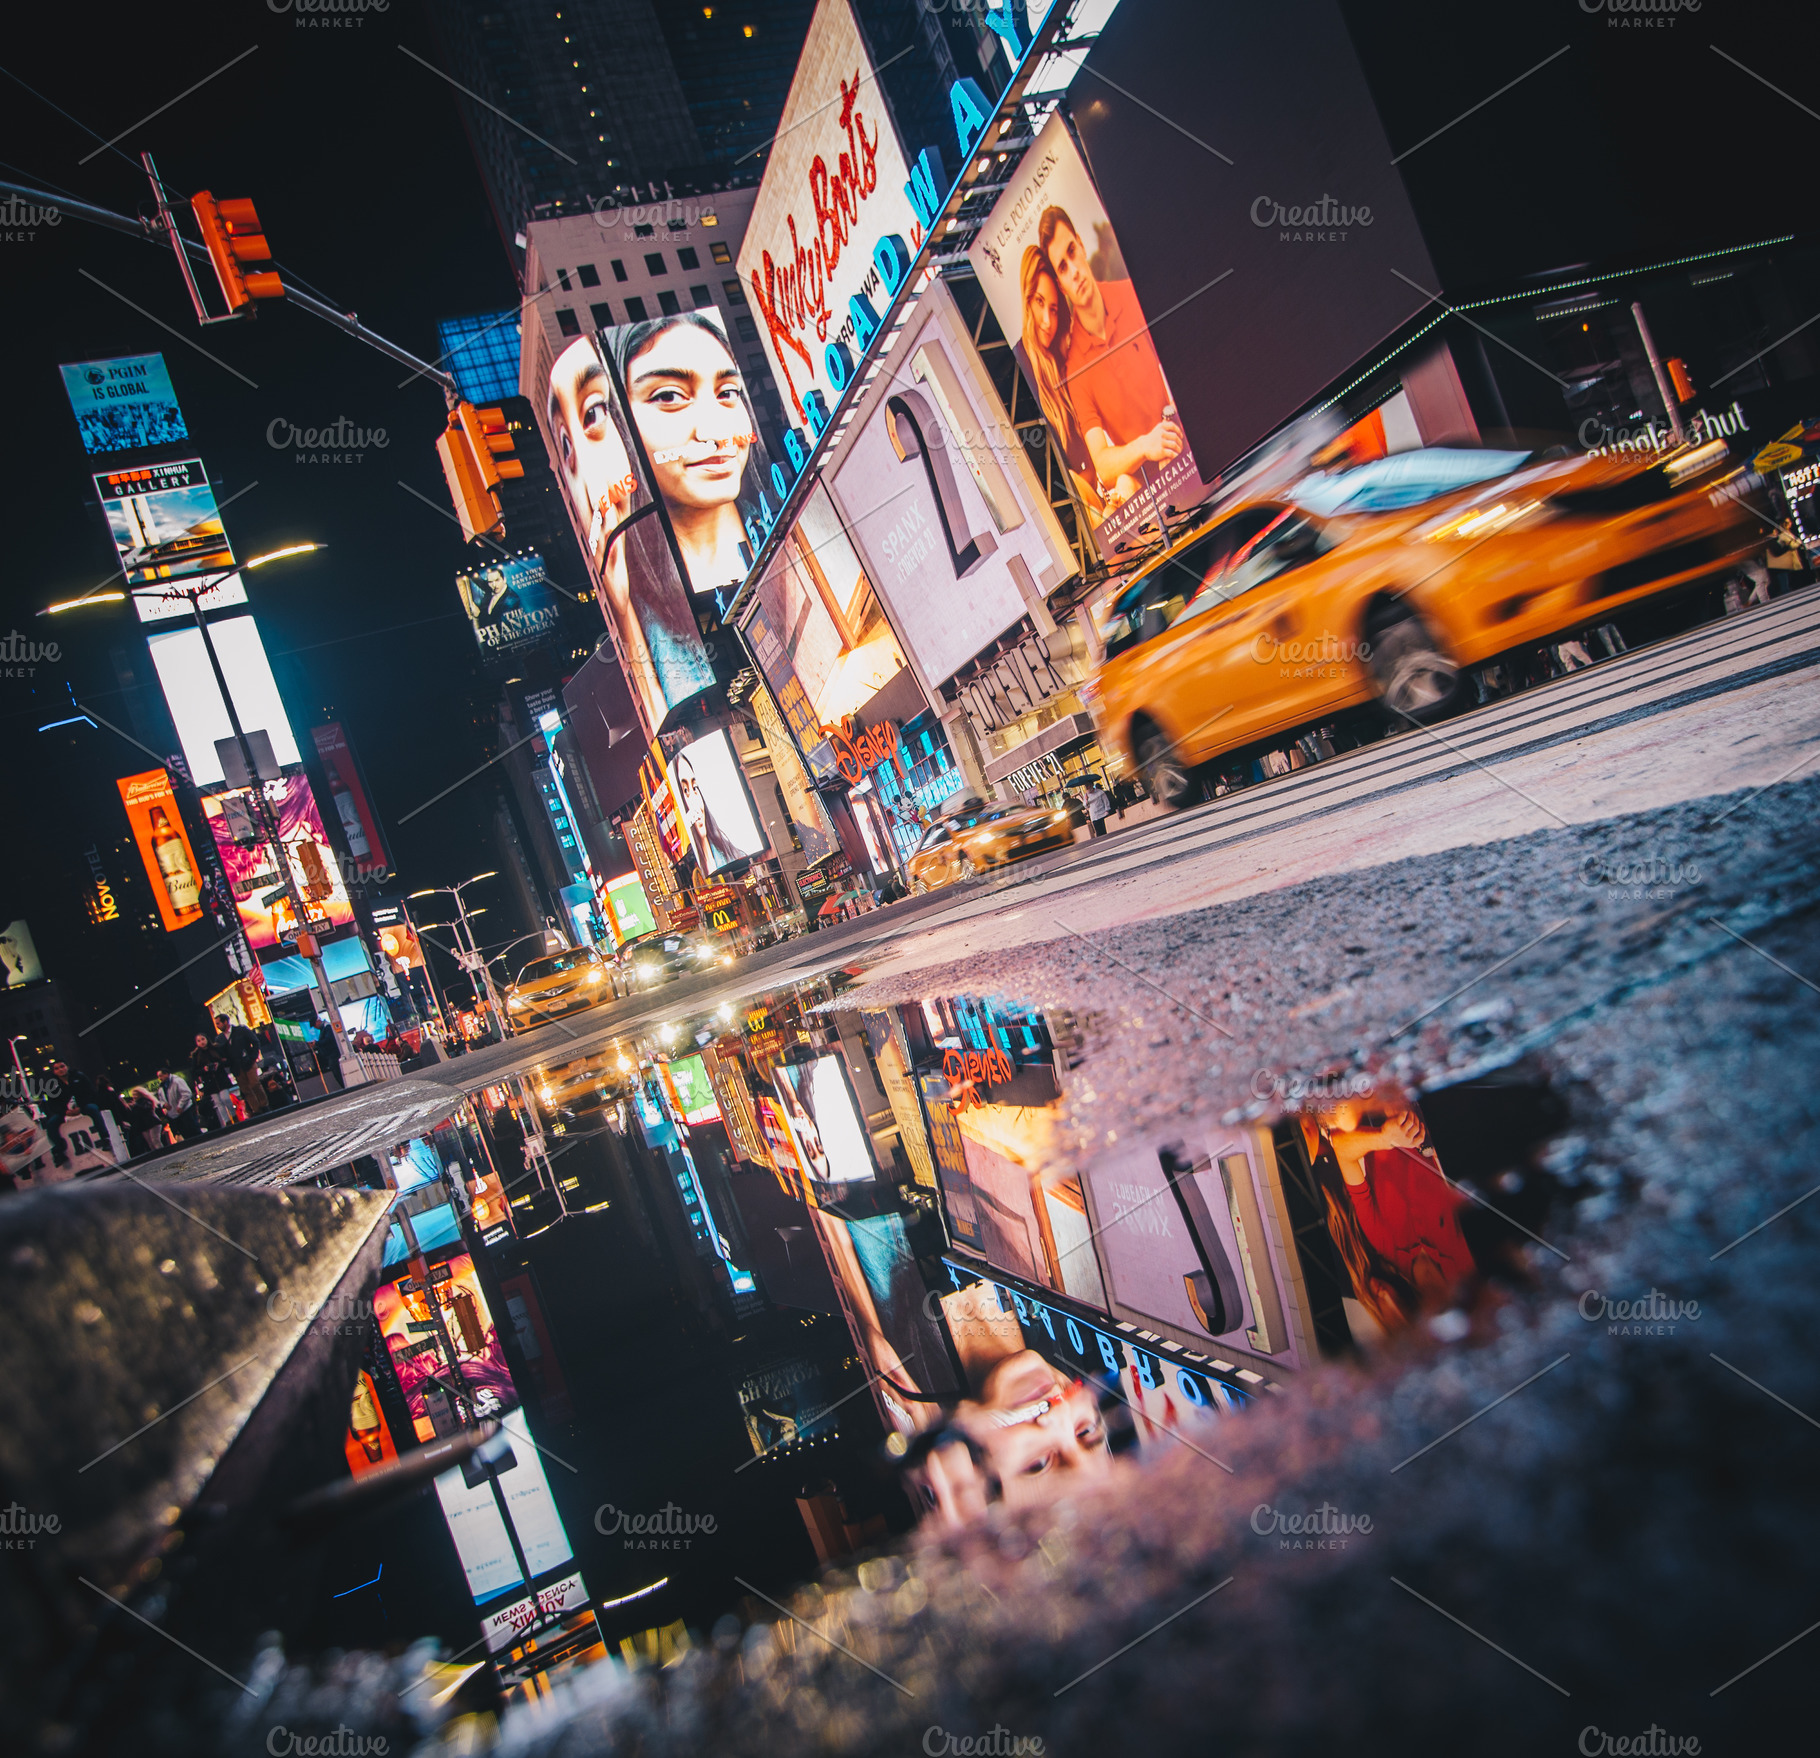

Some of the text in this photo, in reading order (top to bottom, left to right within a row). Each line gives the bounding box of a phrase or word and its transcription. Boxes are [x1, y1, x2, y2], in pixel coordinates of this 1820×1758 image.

[1010, 187, 1034, 227] POLO
[1033, 150, 1059, 193] ASSN.
[752, 68, 878, 426] Kinky Boots
[92, 381, 150, 400] IS GLOBAL
[108, 364, 147, 380] PGIM
[1700, 401, 1750, 440] hut
[153, 464, 189, 478] XINHUA
[884, 339, 1027, 581] 21
[115, 474, 190, 496] GALLERY
[1104, 452, 1193, 535] LIVE AUTHENTICALLY
[881, 500, 927, 563] SPANX
[898, 538, 928, 579] FOREVER
[925, 526, 936, 547] 21
[477, 605, 560, 643] PHANTOM
[487, 637, 500, 647] OF
[501, 629, 523, 641] THE
[523, 620, 556, 635] OPERA
[503, 608, 524, 620] THE
[525, 688, 553, 702] Show your
[527, 694, 556, 709] taste buds
[778, 674, 804, 713] COME
[956, 630, 1067, 741] FOREVER
[786, 694, 816, 736] FROM
[819, 712, 905, 786] Disney
[1007, 752, 1065, 795] FOREVER 21
[84, 843, 120, 921] NOVOTEL
[629, 828, 665, 907] PALACE
[288, 930, 302, 941] ON
